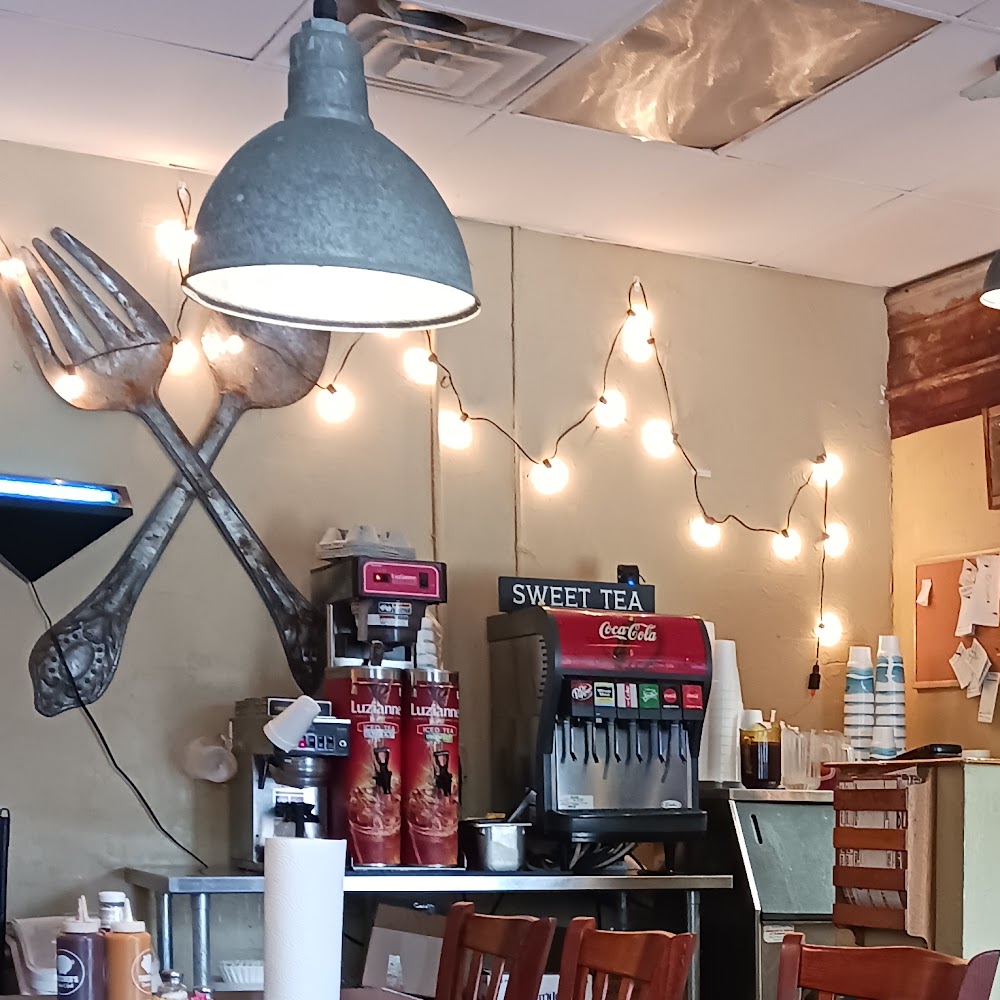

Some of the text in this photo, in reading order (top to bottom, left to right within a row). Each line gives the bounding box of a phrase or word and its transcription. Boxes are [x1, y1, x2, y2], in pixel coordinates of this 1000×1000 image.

[512, 583, 644, 612] SWEET TEA
[599, 621, 657, 642] Coca-Cola
